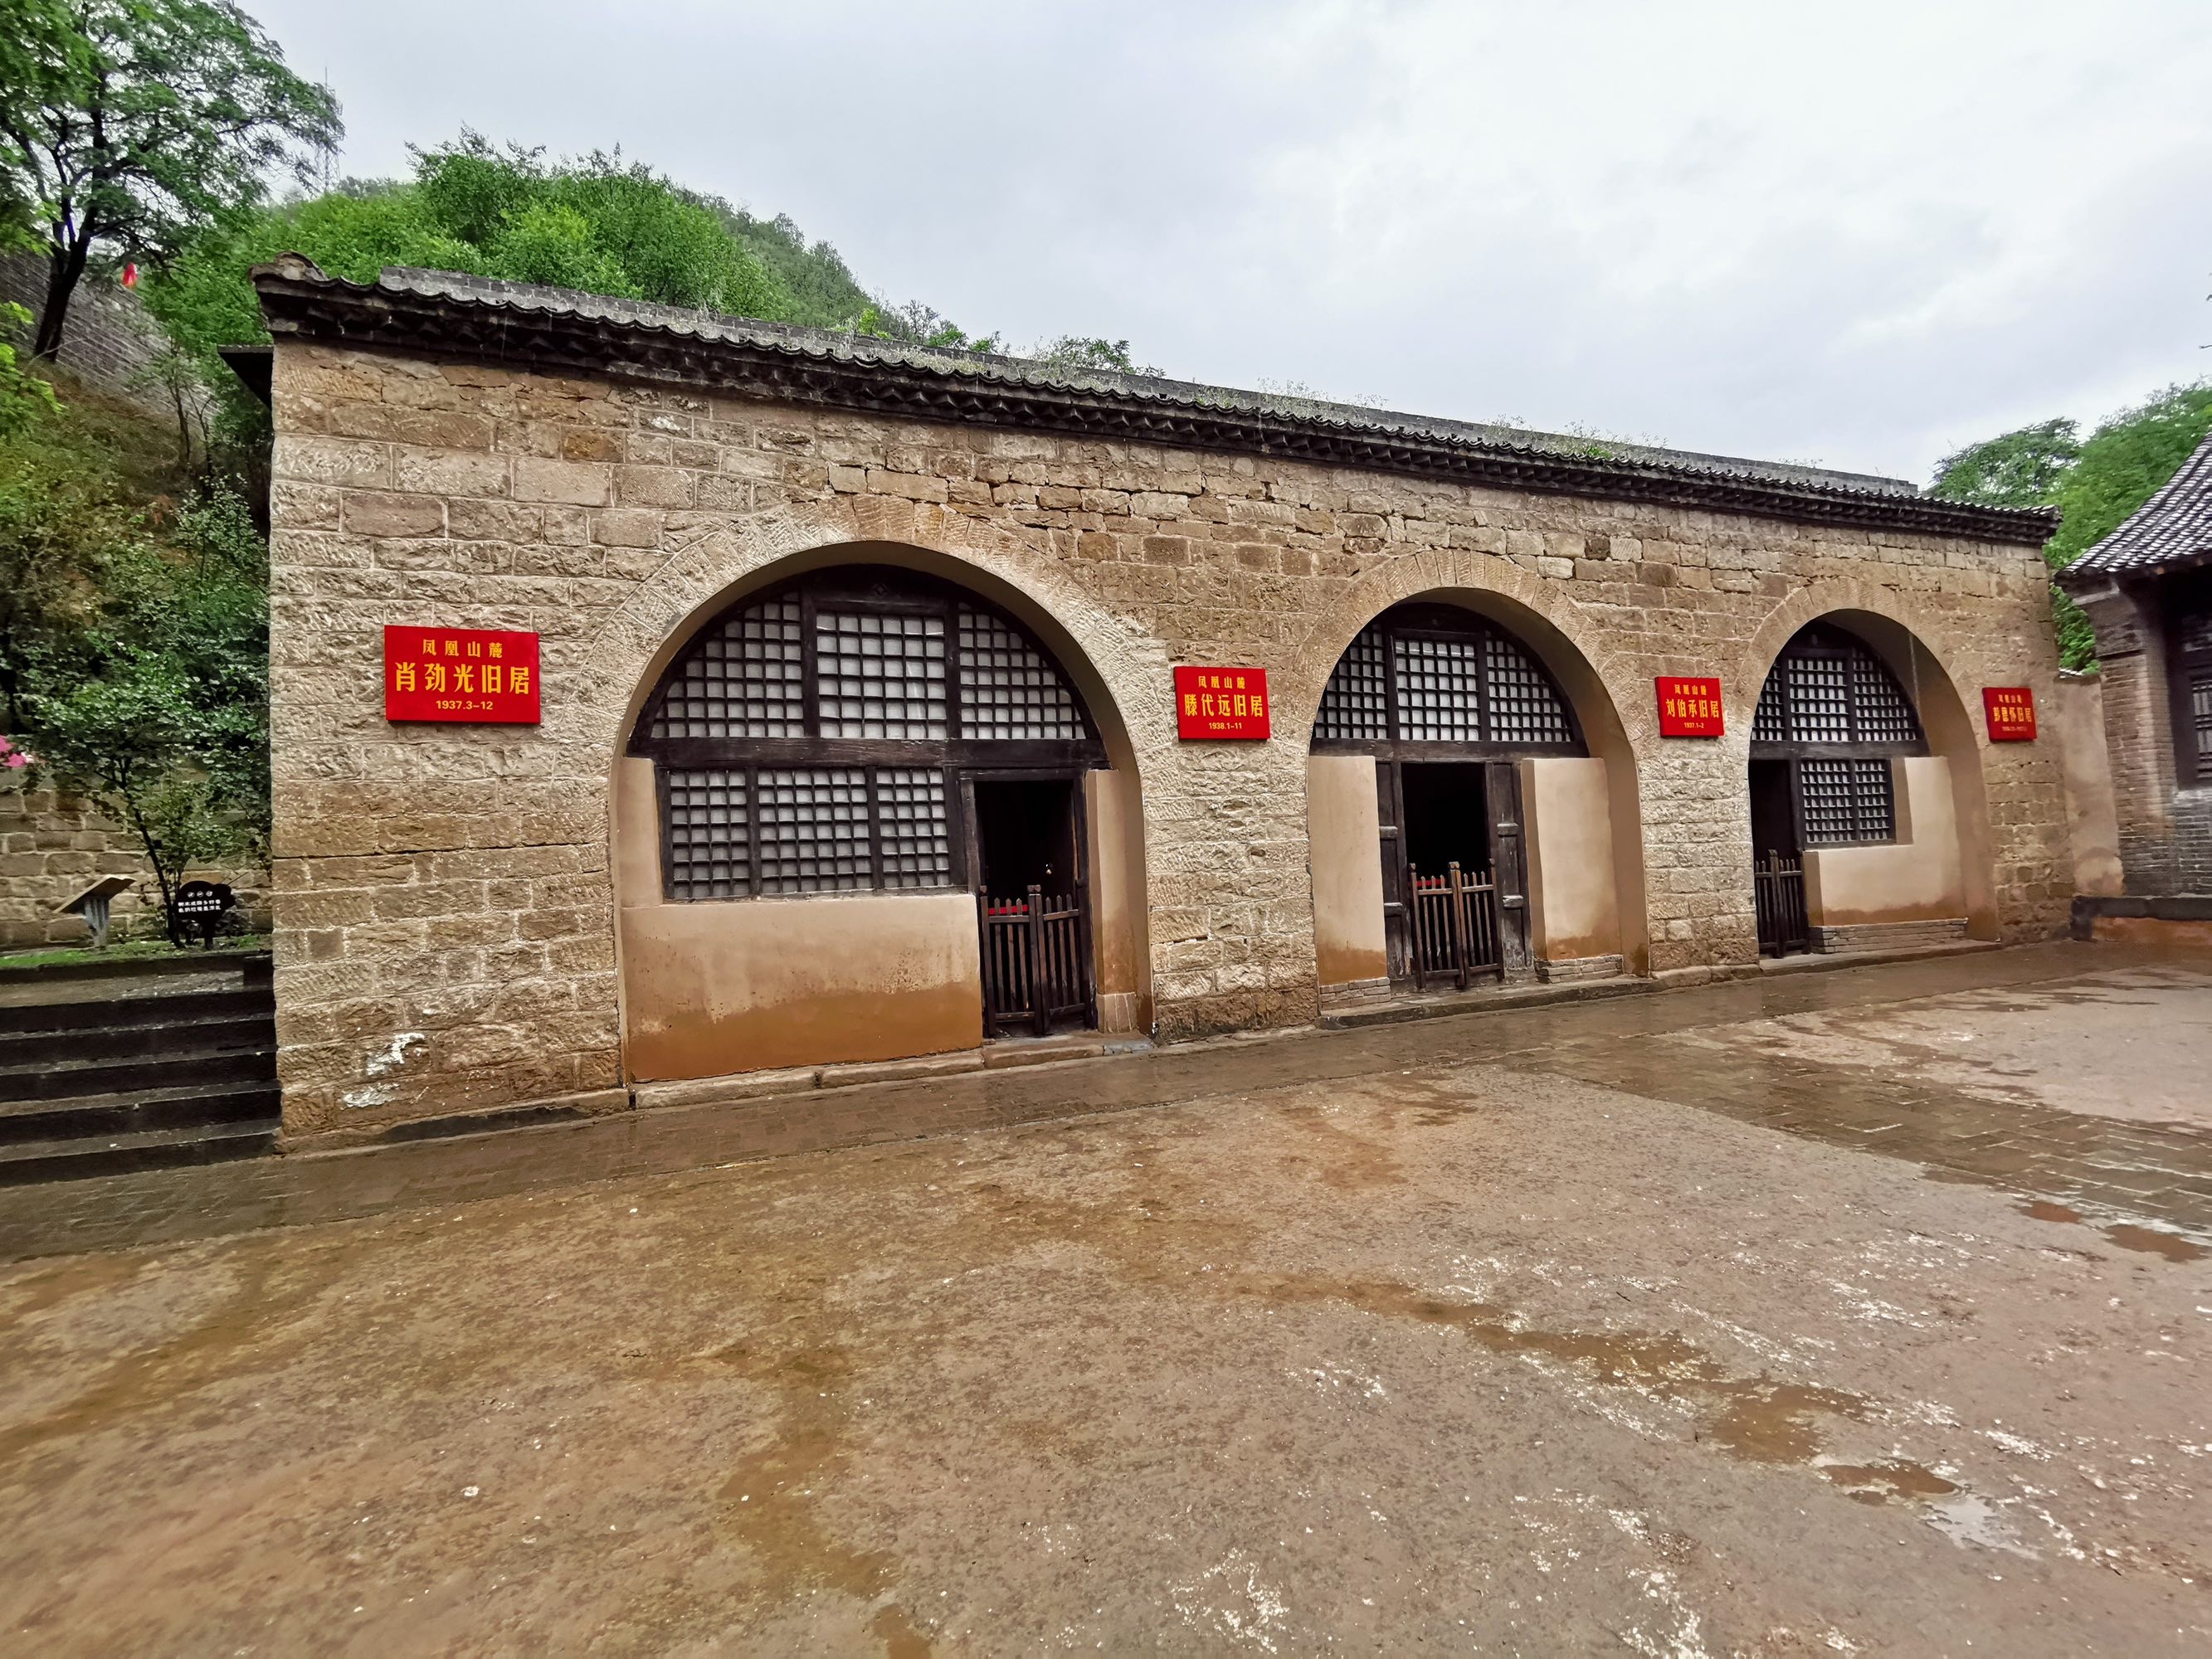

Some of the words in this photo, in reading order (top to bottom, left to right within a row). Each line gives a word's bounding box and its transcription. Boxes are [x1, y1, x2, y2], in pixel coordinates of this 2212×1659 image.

[423, 640, 503, 658] 凤凰山麓
[395, 662, 529, 694] 肖劲光旧居
[1198, 676, 1245, 689] 凤凰山麓
[436, 700, 494, 710] 1937.3-12
[1184, 693, 1264, 718] 滕代远旧居
[1666, 698, 1719, 718] 刘伯承旧居
[1208, 722, 1242, 730] 1938.1-11
